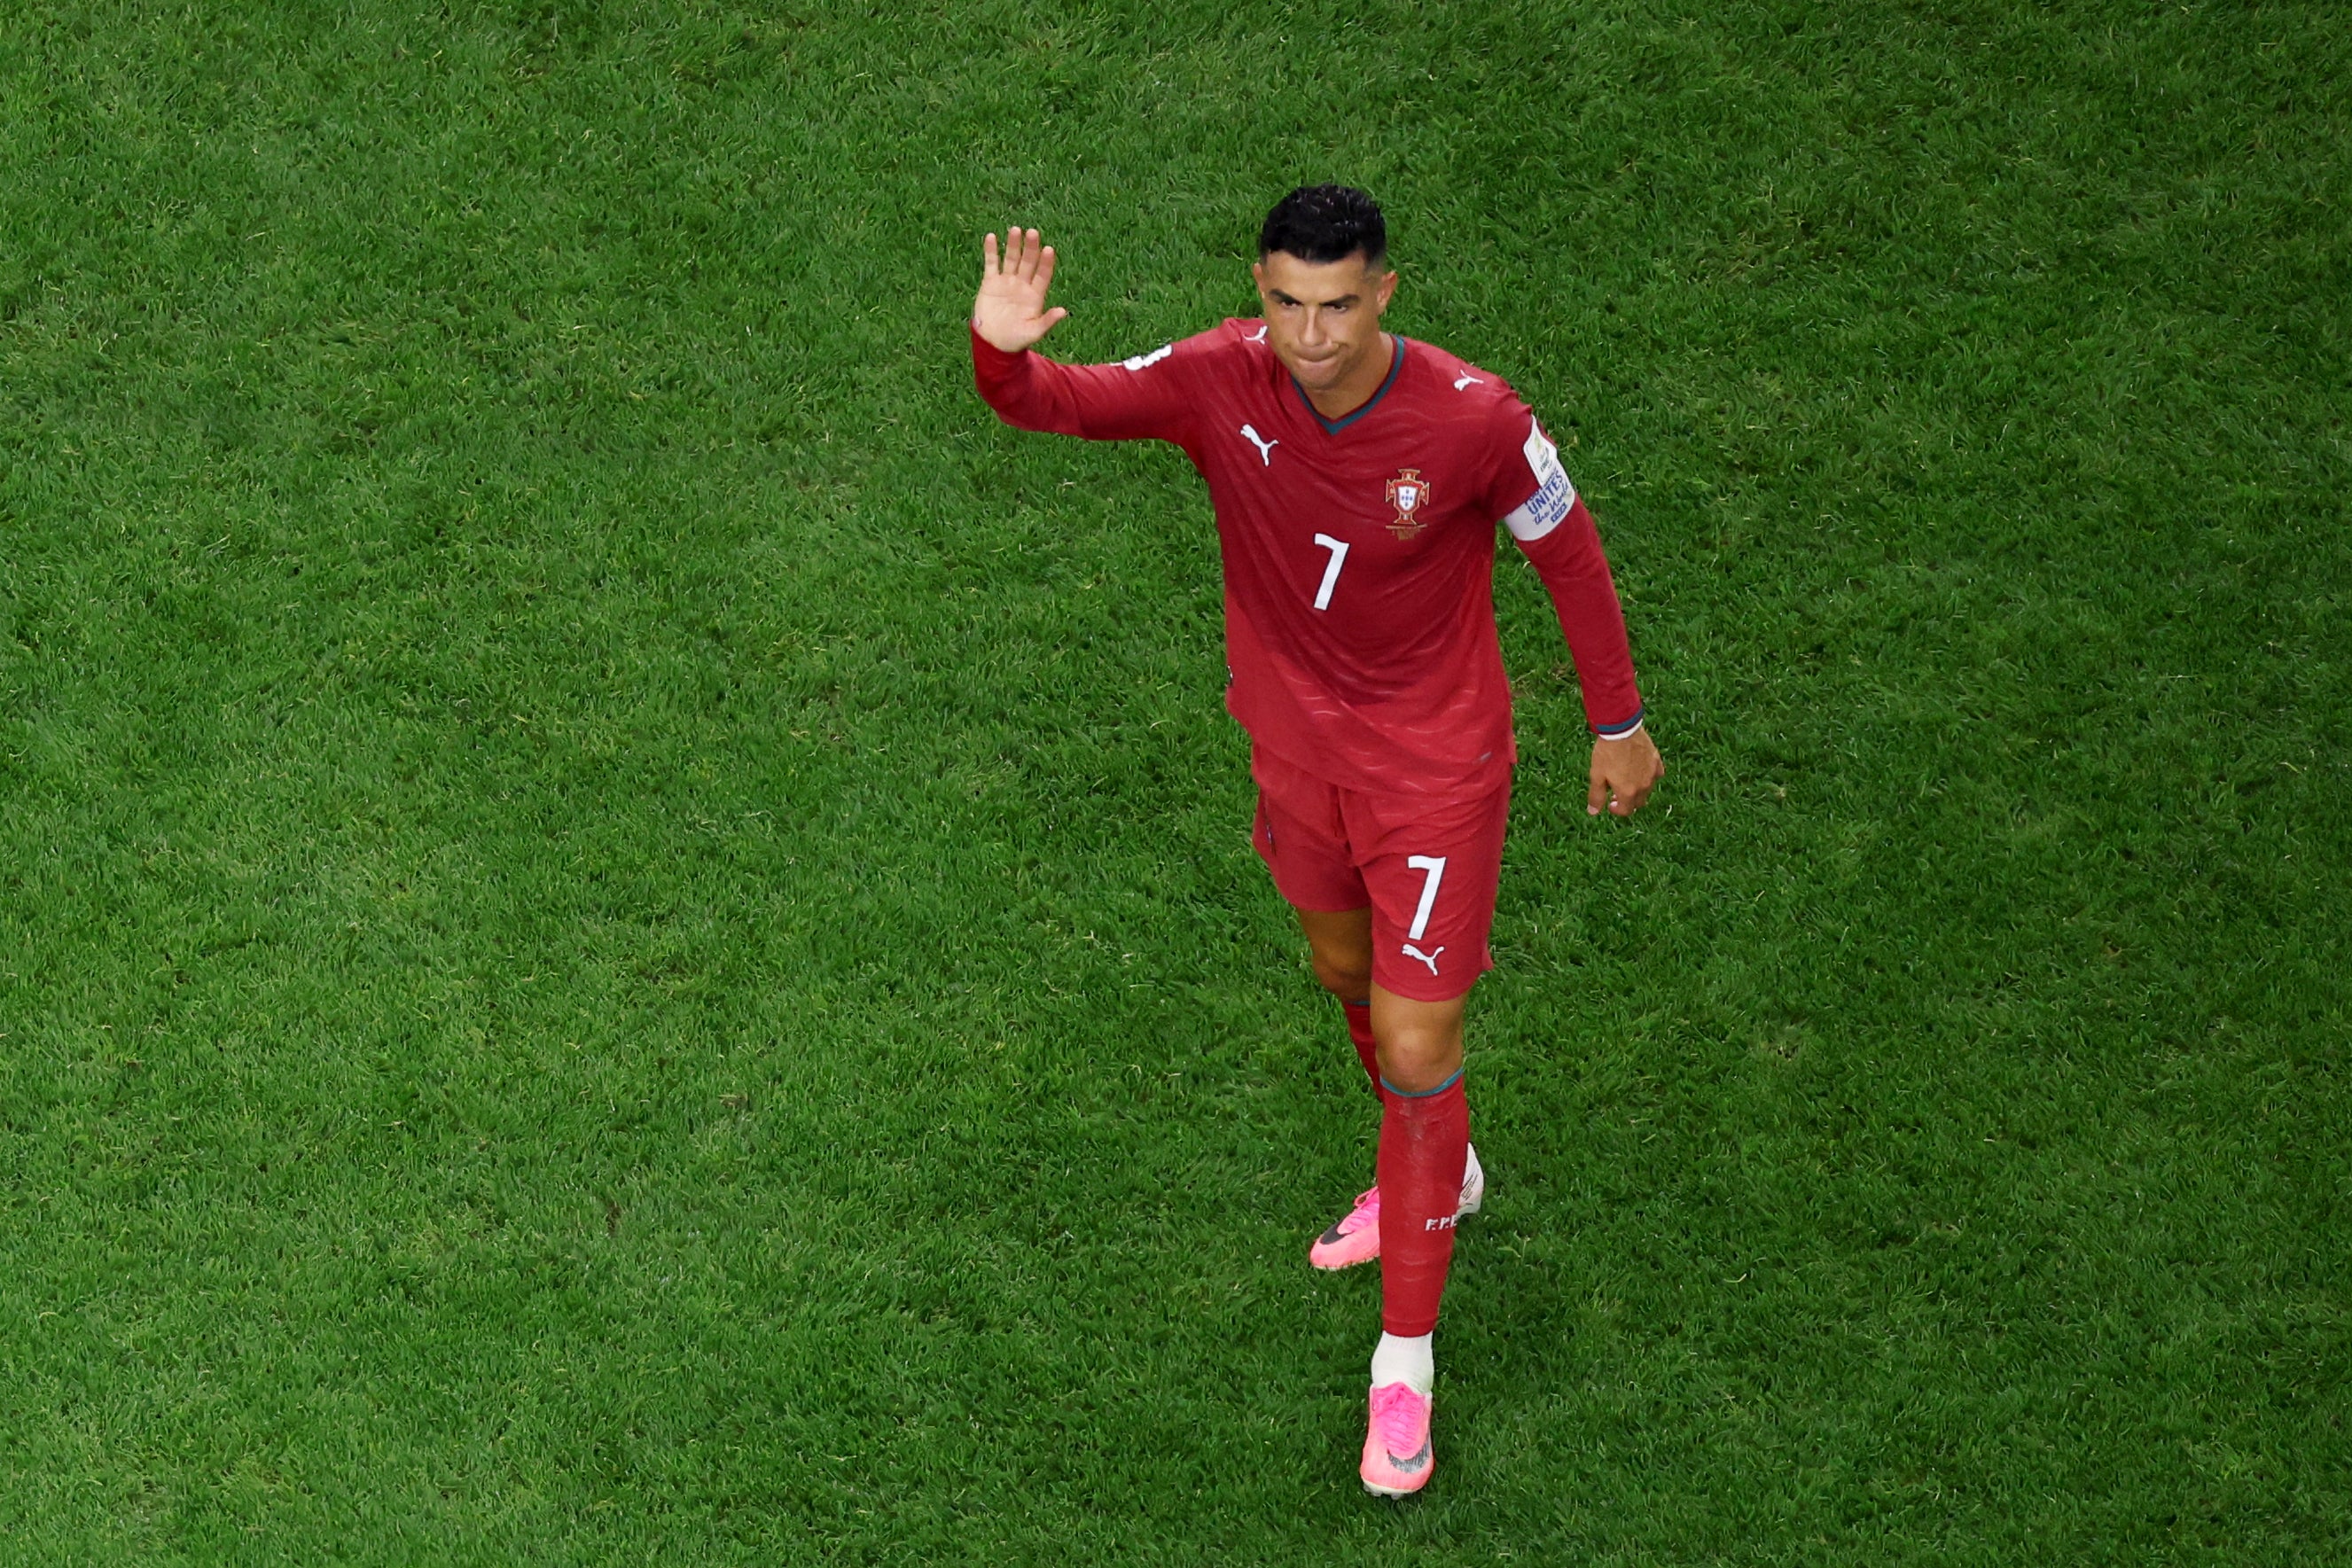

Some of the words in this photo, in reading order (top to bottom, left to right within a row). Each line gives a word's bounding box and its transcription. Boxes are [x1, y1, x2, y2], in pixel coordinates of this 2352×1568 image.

[1527, 470, 1563, 515] UNITES
[1314, 533, 1350, 611] 7
[1408, 855, 1447, 940] 7
